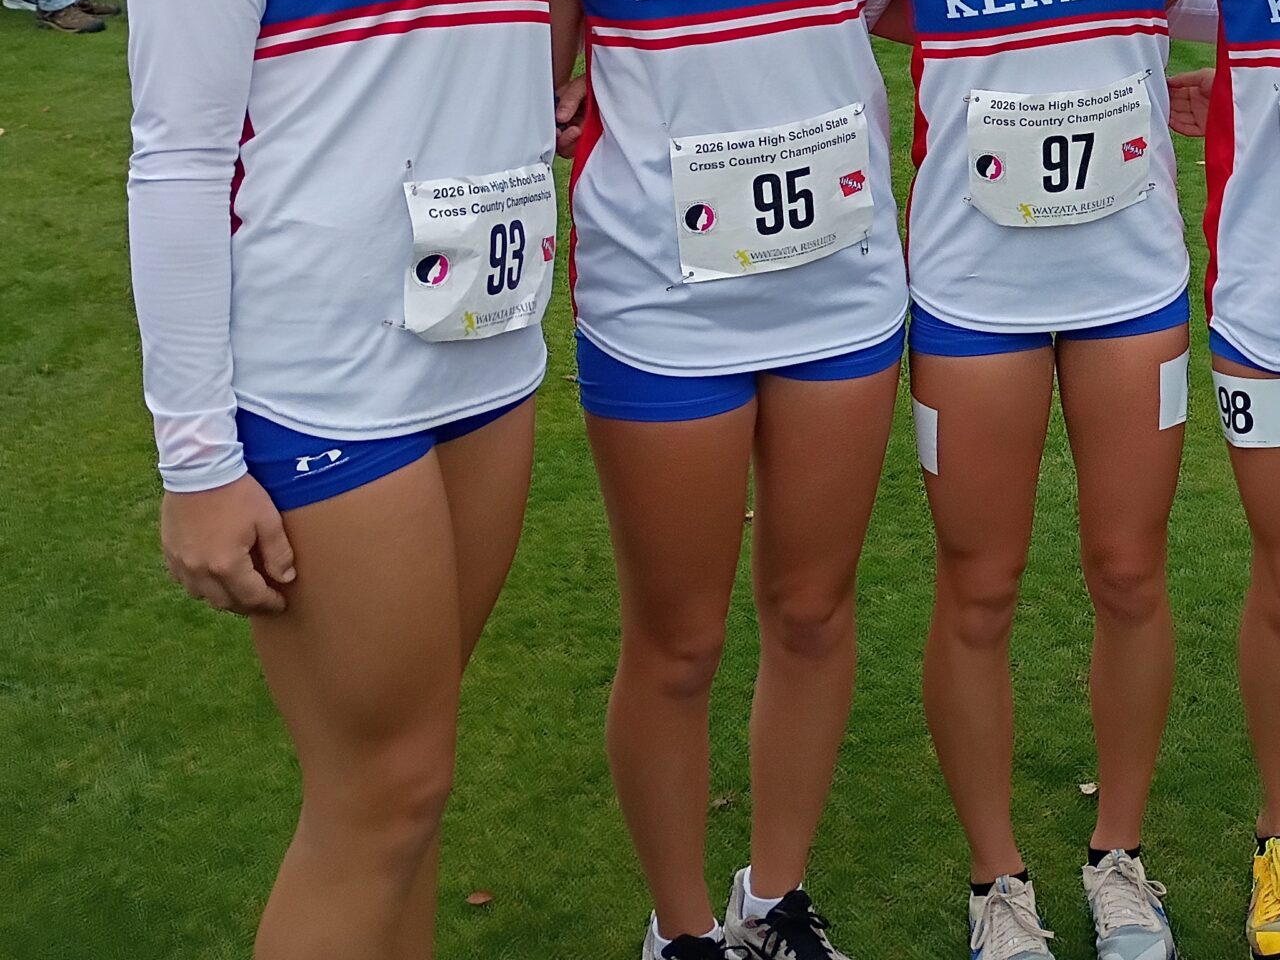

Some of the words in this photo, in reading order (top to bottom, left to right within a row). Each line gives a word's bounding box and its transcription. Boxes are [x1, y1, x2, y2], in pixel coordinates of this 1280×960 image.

[983, 115, 1016, 127] Cross
[1019, 113, 1064, 127] Country
[1067, 99, 1140, 124] Championships
[990, 99, 1016, 111] 2026
[1019, 101, 1045, 112] Iowa
[1048, 99, 1074, 113] High
[1077, 93, 1112, 107] School
[1113, 85, 1134, 100] State
[689, 159, 725, 172] Cross
[729, 152, 777, 167] Country
[780, 130, 856, 160] Championships
[695, 141, 724, 155] 2026
[727, 139, 755, 152] Iowa
[758, 134, 786, 147] High
[788, 123, 824, 141] School
[825, 115, 849, 131] State
[1042, 132, 1095, 193] 97
[428, 205, 467, 219] Cross
[471, 198, 505, 214] Country
[506, 190, 552, 209] Championships
[433, 185, 465, 200] 2026
[468, 182, 490, 195] Iowa
[489, 179, 509, 193] High
[508, 173, 532, 189] School
[532, 172, 546, 183] State
[752, 166, 815, 236] 95
[1032, 204, 1078, 216] WAYZATA
[1080, 195, 1115, 211] RESULTS
[486, 219, 526, 296] 93
[1218, 386, 1254, 434] 98
